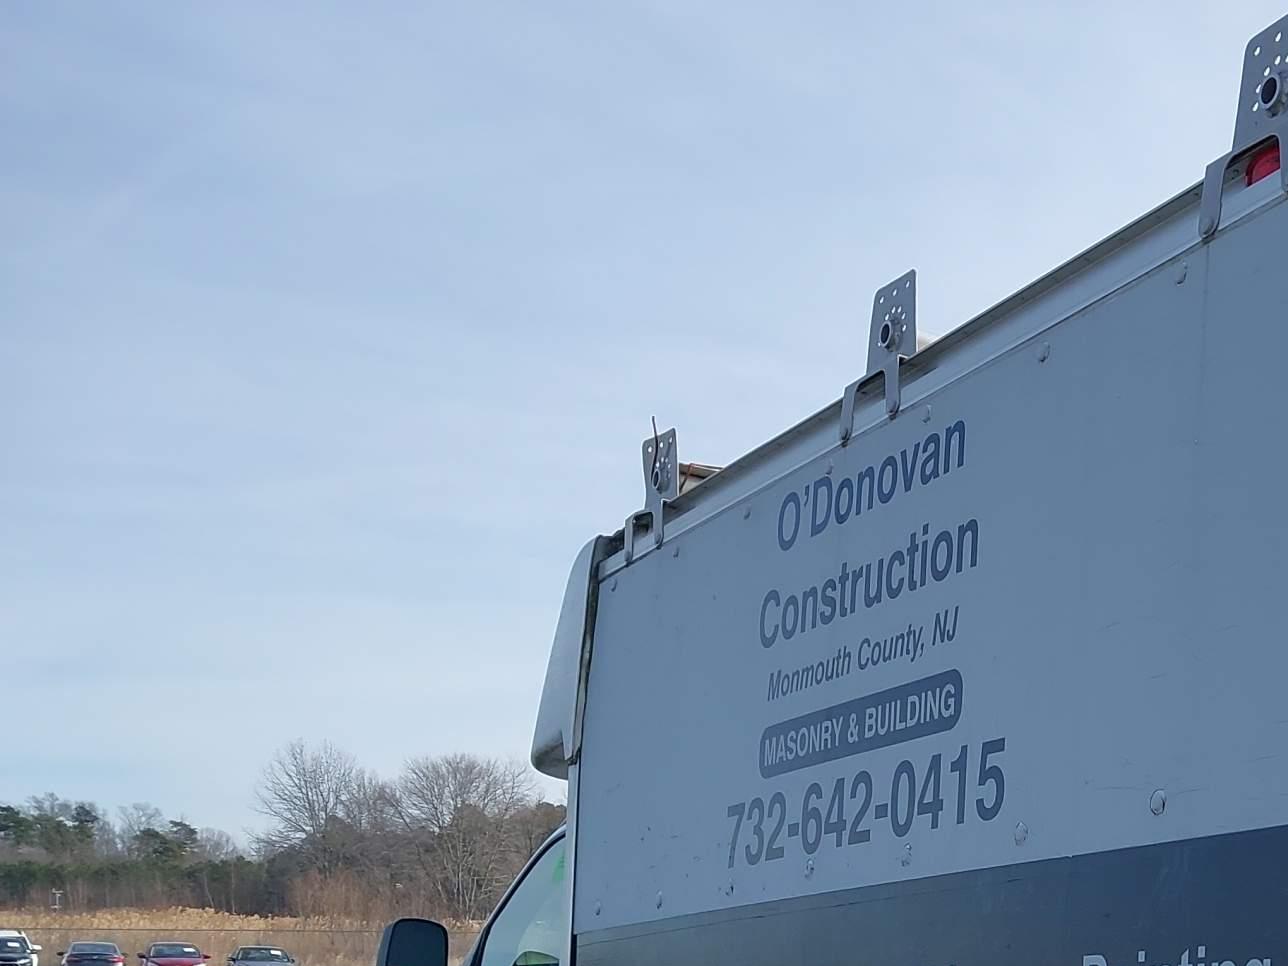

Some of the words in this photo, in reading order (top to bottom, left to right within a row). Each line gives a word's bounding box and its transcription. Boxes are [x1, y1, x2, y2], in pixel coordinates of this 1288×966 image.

[777, 420, 966, 551] O'Donovan
[759, 518, 979, 648] Construction
[767, 646, 851, 701] Monmouth
[857, 624, 924, 670] County,
[932, 606, 959, 646] NJ
[764, 716, 844, 767] MASONRY
[848, 713, 859, 744] &
[864, 683, 956, 739] BUILDING
[727, 737, 1006, 869] 732-642-0415
